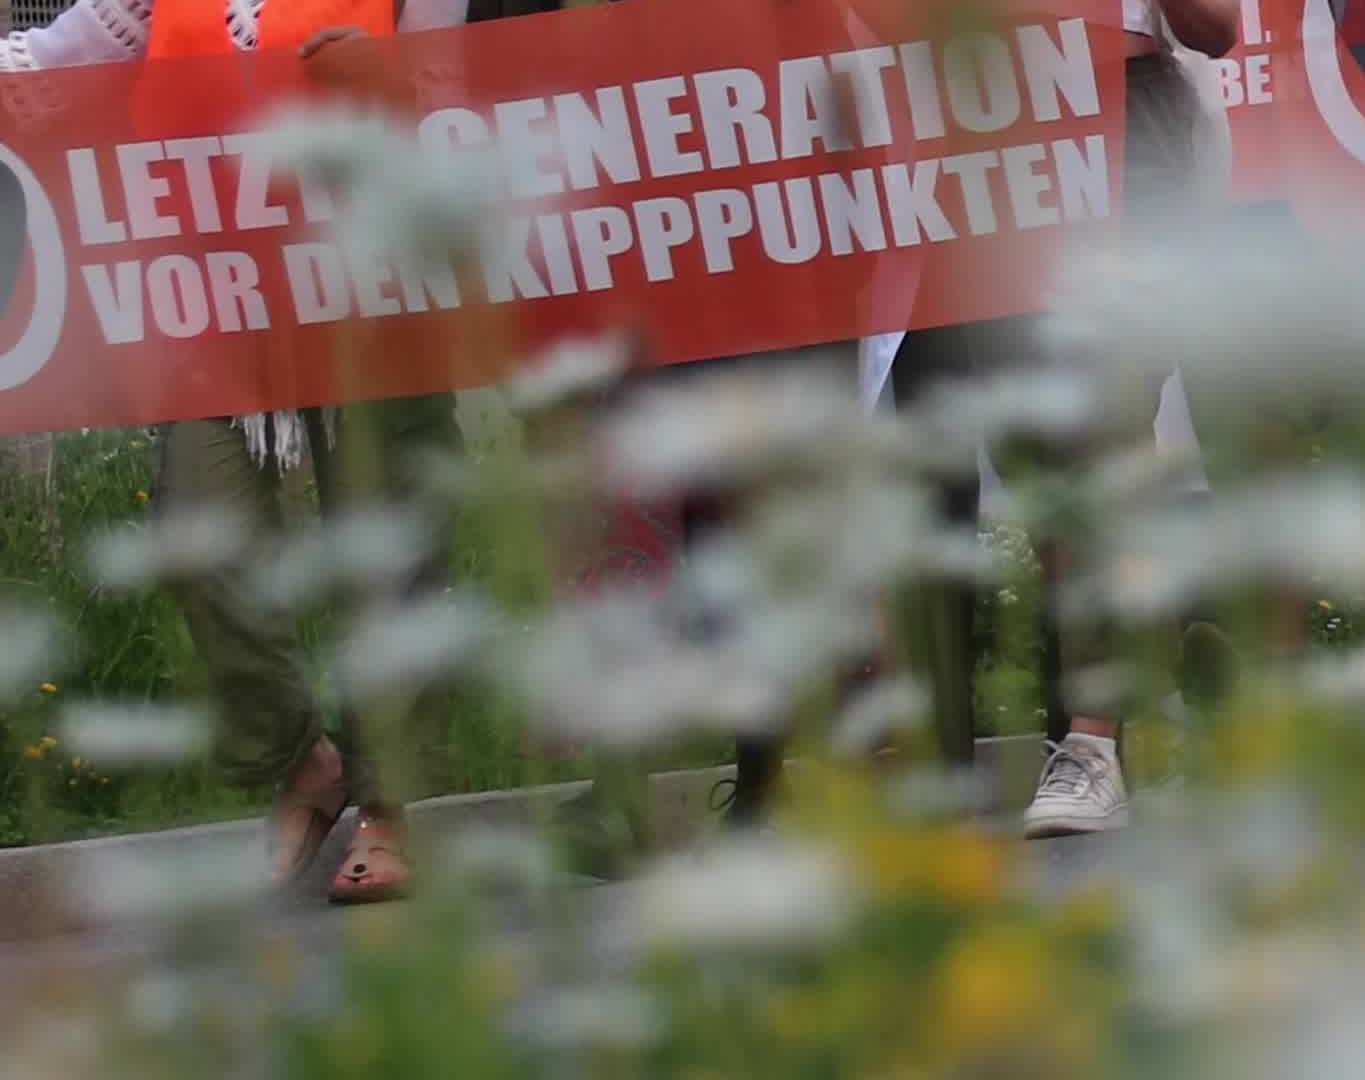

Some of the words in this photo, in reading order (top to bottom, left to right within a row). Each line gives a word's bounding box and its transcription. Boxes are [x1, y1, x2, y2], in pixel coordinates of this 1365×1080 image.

[417, 18, 1101, 206] GENERATION
[80, 250, 271, 345] VOR
[484, 134, 1112, 305] KIPPPUNKTEN
